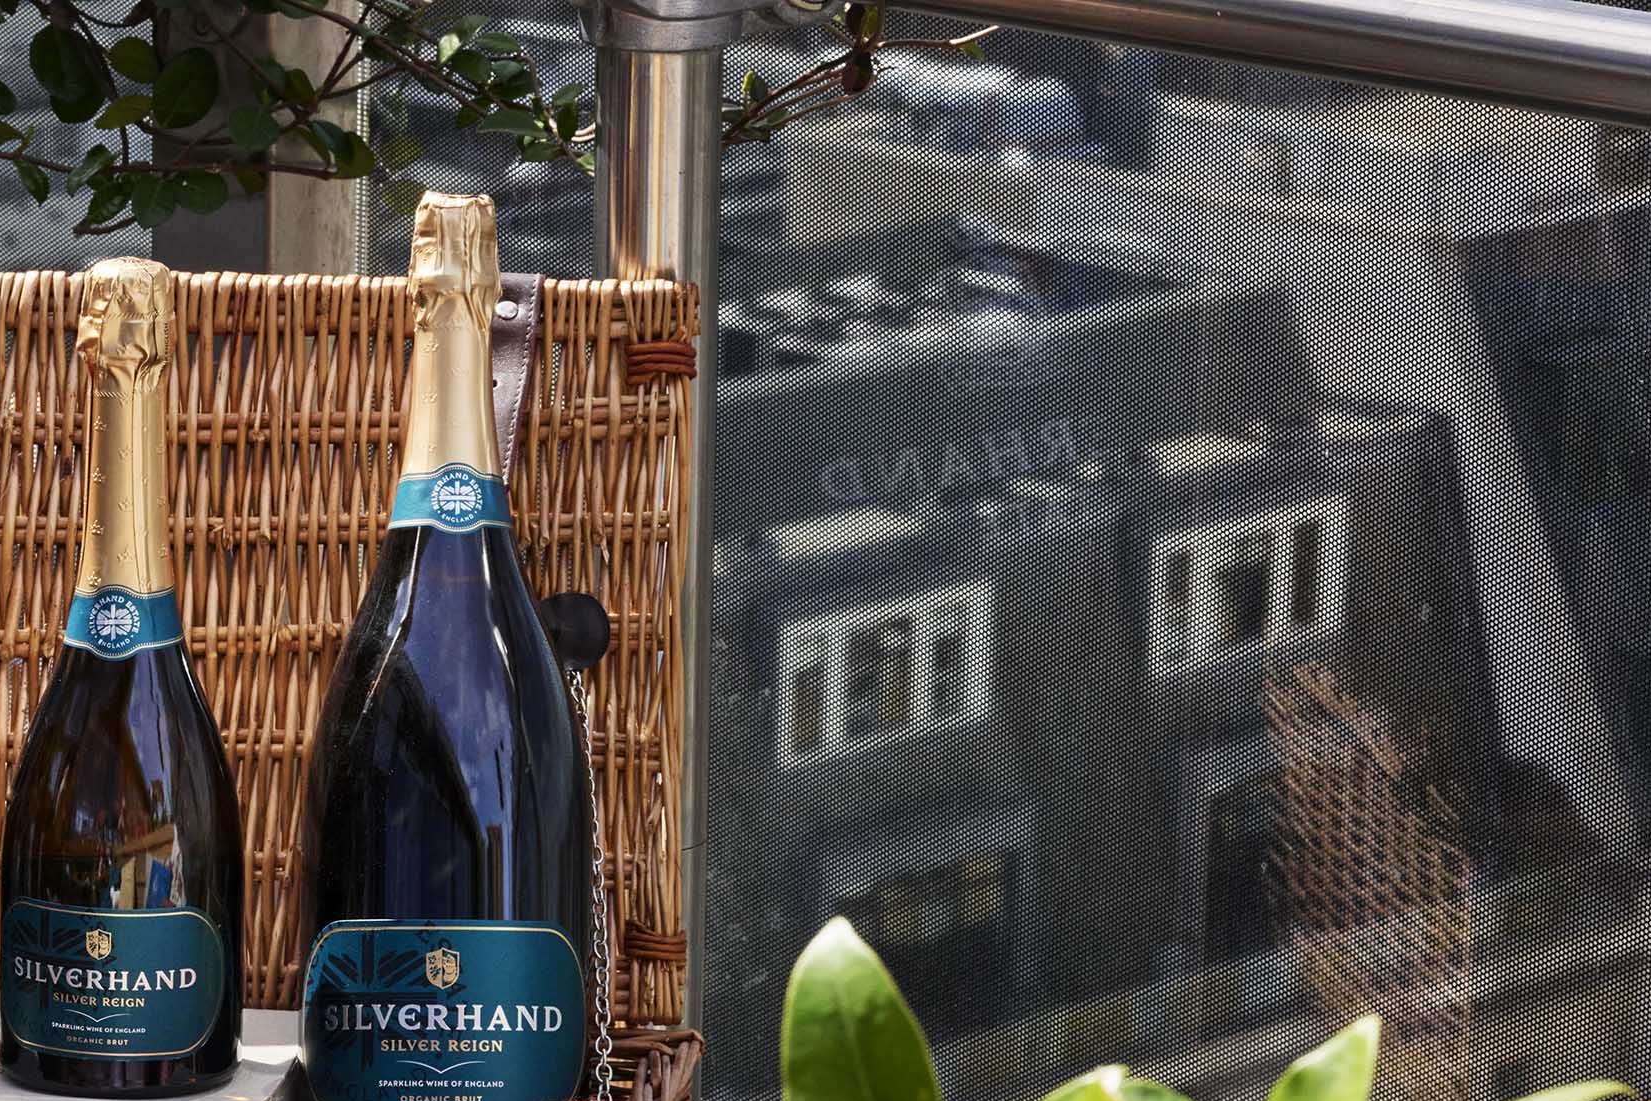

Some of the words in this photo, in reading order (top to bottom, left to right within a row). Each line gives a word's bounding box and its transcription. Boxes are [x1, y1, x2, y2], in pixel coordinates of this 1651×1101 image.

[431, 472, 469, 511] SILVERHAND
[469, 479, 484, 510] ESTATE
[441, 514, 474, 523] ENGLAND
[89, 595, 125, 635] SILVERHAND
[125, 601, 141, 634] ESTATE
[97, 638, 131, 649] ENGLAND
[14, 956, 197, 992] SILVERHAND
[53, 992, 98, 1007] SILVER
[102, 997, 145, 1008] REIGN
[324, 1003, 563, 1033] SILVERHAND
[51, 1021, 85, 1032] SPARKLING
[86, 1025, 103, 1033] WINE
[67, 1035, 104, 1045] ORGANIC
[106, 1038, 129, 1046] BRUT
[380, 1039, 442, 1052] SILVER
[448, 1039, 503, 1053] REIGN
[378, 1079, 424, 1088] SPARKLING
[426, 1079, 449, 1088] WINE
[451, 1080, 462, 1088] OF
[464, 1080, 504, 1088] ENGLAND
